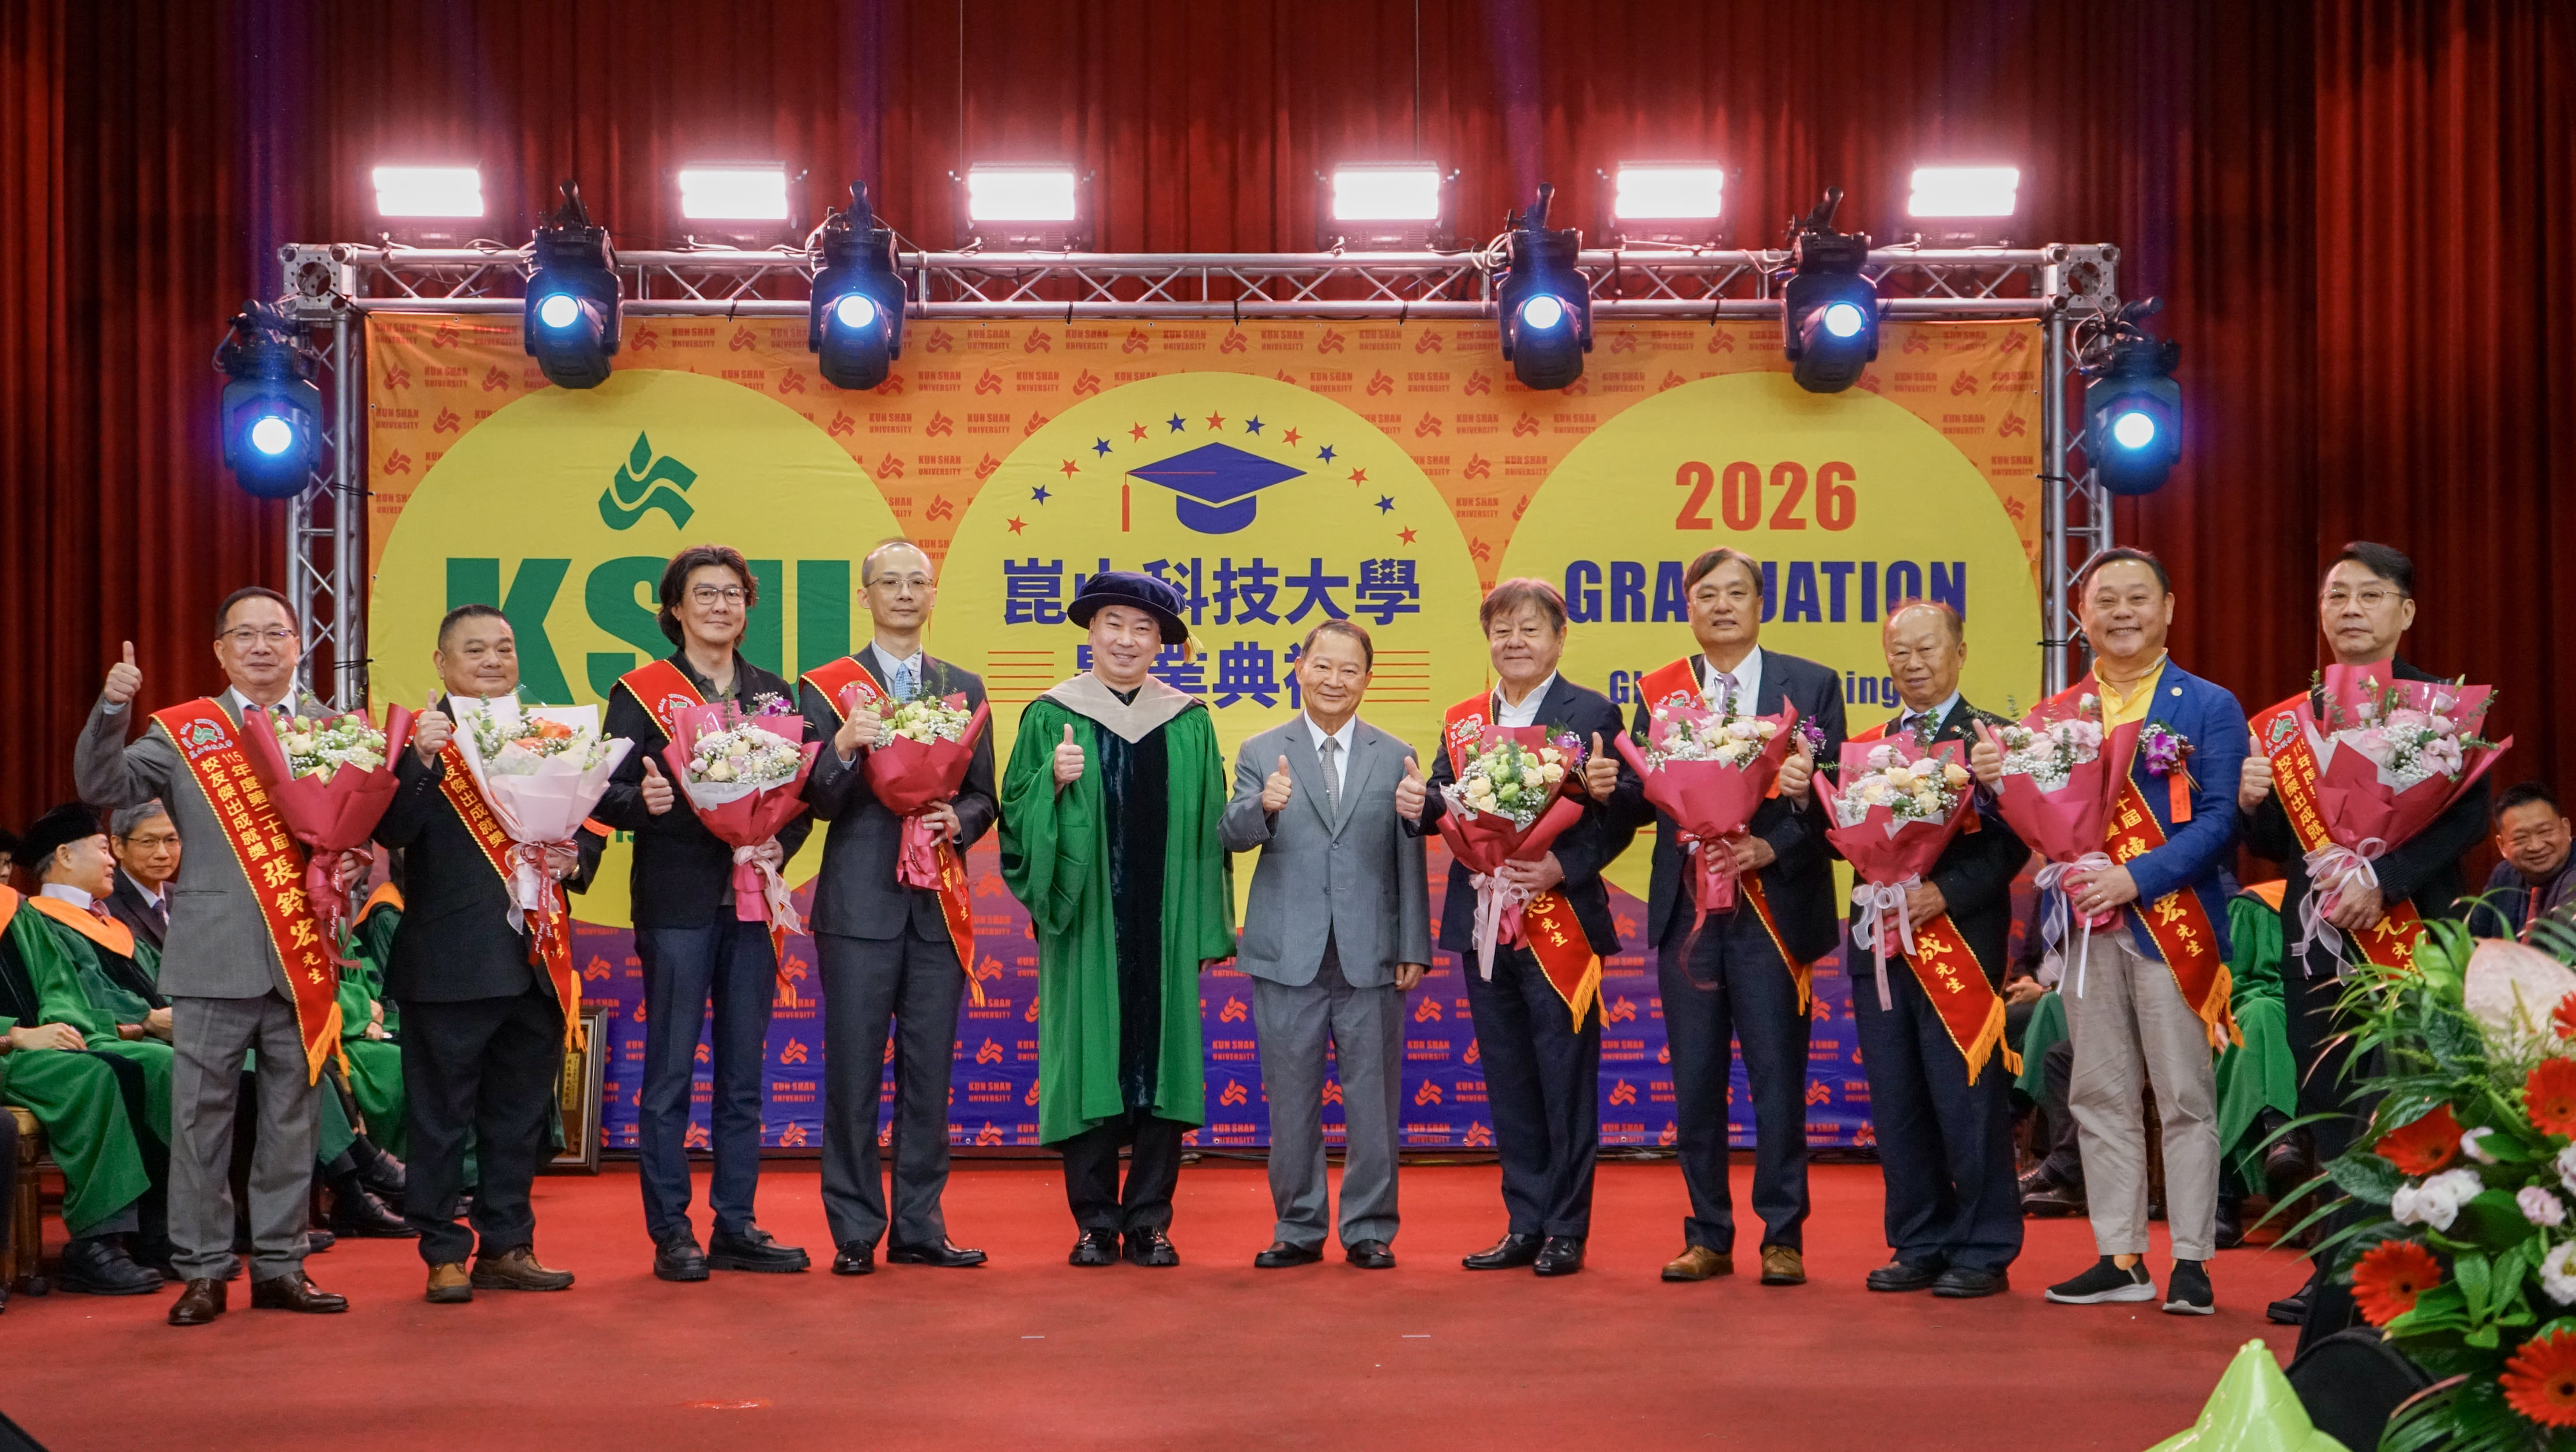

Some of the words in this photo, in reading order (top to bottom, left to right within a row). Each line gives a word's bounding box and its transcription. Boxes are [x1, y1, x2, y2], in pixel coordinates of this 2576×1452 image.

[672, 327, 690, 336] KUN
[692, 327, 715, 336] SHAN
[967, 329, 985, 338] KUN
[987, 329, 1010, 338] SHAN
[1065, 329, 1083, 338] KUN
[1085, 329, 1108, 338] SHAN
[1163, 330, 1181, 339] KUN
[1183, 330, 1206, 339] SHAN
[1261, 330, 1279, 339] KUN
[1281, 330, 1304, 339] SHAN
[1359, 330, 1377, 339] KUN
[1378, 330, 1401, 339] SHAN
[1163, 343, 1206, 351] UNIVERSITY
[1261, 343, 1304, 351] UNIVERSITY
[1359, 343, 1401, 351] UNIVERSITY
[425, 367, 443, 376] KUN
[444, 367, 467, 376] SHAN
[722, 370, 739, 379] KUN
[741, 370, 764, 379] SHAN
[918, 371, 936, 379] KUN
[937, 371, 961, 379] SHAN
[1016, 371, 1034, 381] KUN
[1035, 371, 1059, 381] SHAN
[1114, 371, 1132, 381] KUN
[1310, 372, 1327, 381] KUN
[1330, 372, 1353, 381] SHAN
[1408, 372, 1425, 381] KUN
[1428, 372, 1451, 381] SHAN
[1895, 372, 1912, 381] KUN
[1914, 372, 1937, 381] SHAN
[1016, 384, 1059, 392] UNIVERSITY
[376, 408, 393, 417] KUN
[396, 408, 419, 417] SHAN
[869, 413, 887, 422] KUN
[889, 413, 912, 422] SHAN
[967, 413, 985, 422] KUN
[987, 413, 1010, 422] SHAN
[1378, 413, 1401, 423] SHAN
[1456, 413, 1474, 422] KUN
[1476, 413, 1499, 422] SHAN
[1554, 413, 1572, 422] KUN
[1573, 413, 1596, 422] SHAN
[1943, 414, 1960, 423] KUN
[1963, 414, 1986, 423] SHAN
[869, 426, 912, 434] UNIVERSITY
[967, 426, 1010, 434] UNIVERSITY
[1943, 427, 1985, 435] UNIVERSITY
[918, 455, 936, 464] KUN
[937, 455, 961, 464] SHAN
[1427, 456, 1450, 464] SHAN
[1505, 456, 1522, 465] KUN
[1524, 456, 1547, 465] SHAN
[1991, 456, 2009, 465] KUN
[2011, 456, 2034, 465] SHAN
[1505, 468, 1547, 476] UNIVERSITY
[376, 493, 394, 502] KUN
[1675, 461, 1857, 531] 2026
[889, 496, 912, 506] SHAN
[1456, 497, 1474, 506] KUN
[1476, 497, 1499, 506] SHAN
[1456, 510, 1498, 518] UNIVERSITY
[919, 539, 936, 548] KUN
[1004, 558, 1420, 626] 崑科技大學
[1565, 559, 1967, 623] GRAATION
[1076, 641, 1303, 709] 業典
[200, 755, 269, 862] 校友傑出成就獎
[2275, 754, 2332, 856] 校友傑出成就獎
[1018, 957, 1035, 966] KUN
[1916, 926, 1953, 965] 成
[1935, 962, 1965, 994] 先生
[988, 999, 1011, 1008] SHAN
[773, 1011, 815, 1020] UNIVERSITY
[969, 1011, 1011, 1020] UNIVERSITY
[1018, 1041, 1035, 1049] KUN
[1212, 1041, 1230, 1049] KUN
[1231, 1041, 1255, 1049] SHAN
[1407, 1041, 1425, 1049] KUN
[1426, 1041, 1449, 1049] SHAN
[1602, 1040, 1619, 1049] KUN
[1621, 1040, 1644, 1049] SHAN
[773, 1082, 790, 1091] KUN
[792, 1082, 815, 1091] SHAN
[969, 1082, 986, 1091] KUN
[988, 1082, 1011, 1091] SHAN
[1456, 1082, 1474, 1091] KUN
[1018, 1124, 1035, 1133] KUN
[1212, 1124, 1230, 1134] KUN
[1231, 1124, 1255, 1134] SHAN
[1407, 1124, 1425, 1133] KUN
[1426, 1124, 1449, 1133] SHAN
[1602, 1124, 1620, 1133] KUN
